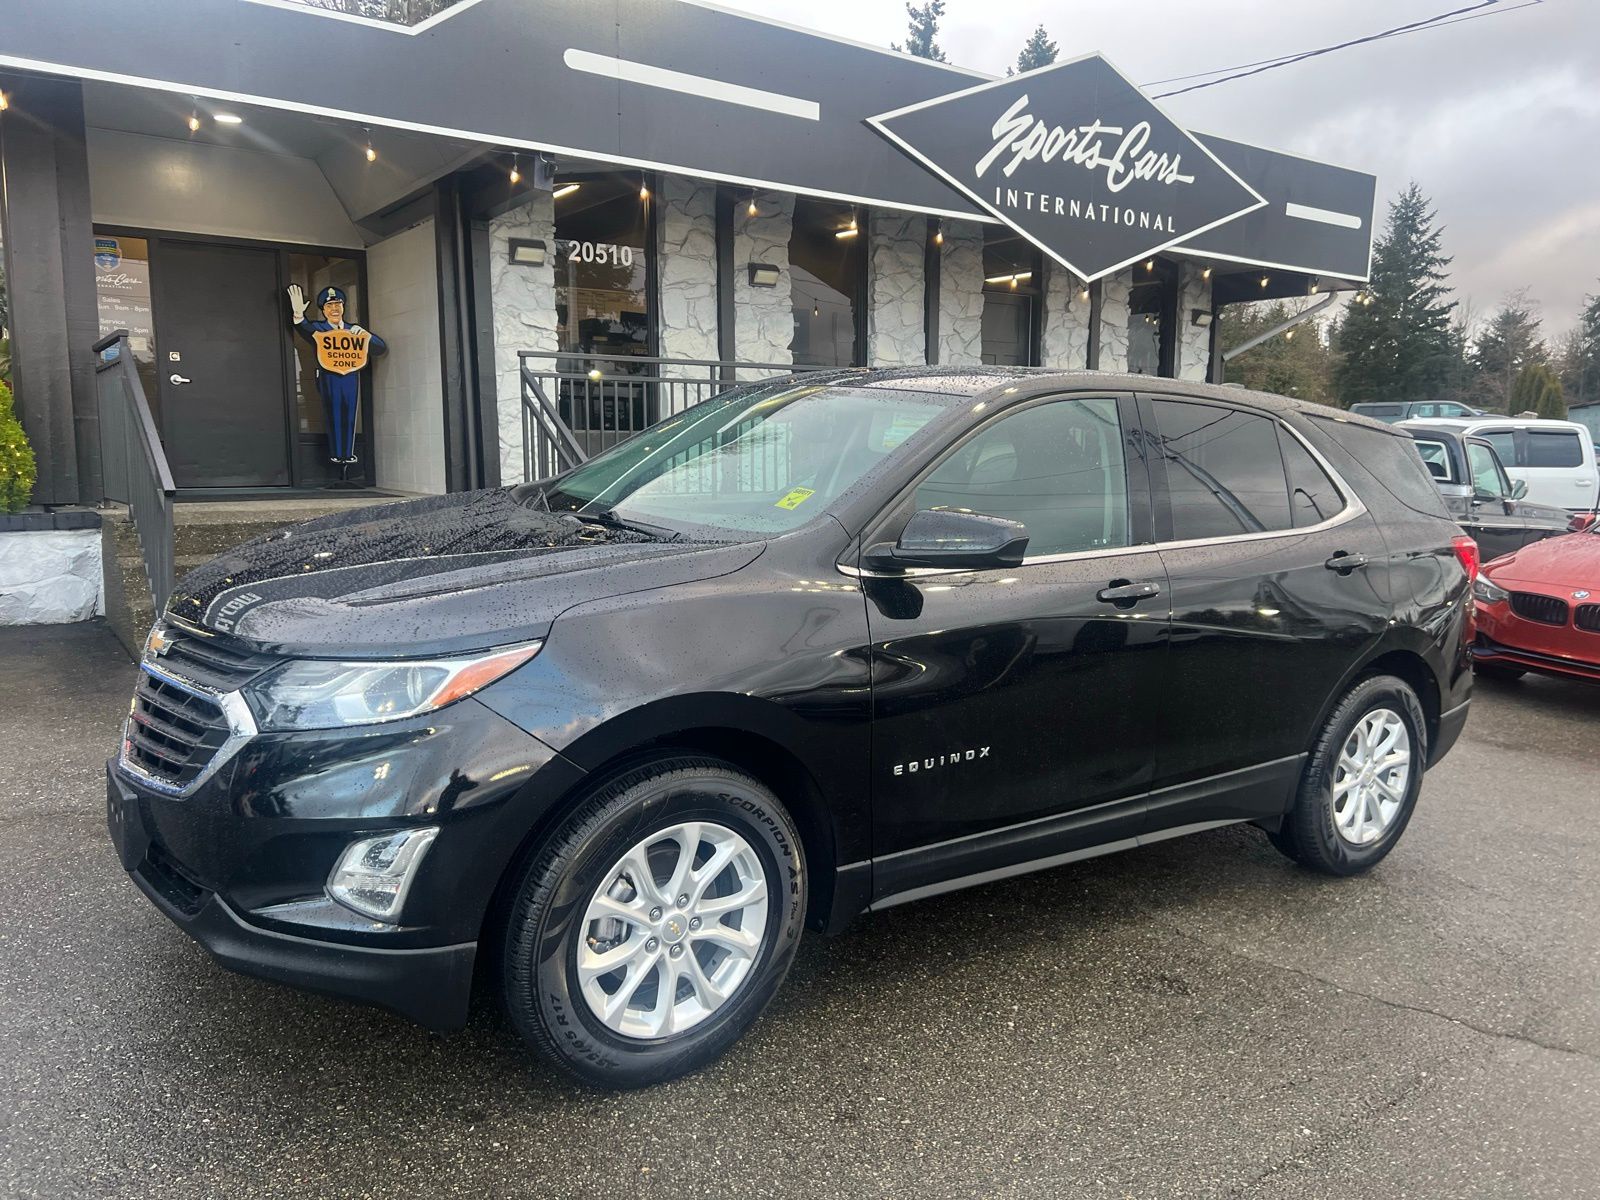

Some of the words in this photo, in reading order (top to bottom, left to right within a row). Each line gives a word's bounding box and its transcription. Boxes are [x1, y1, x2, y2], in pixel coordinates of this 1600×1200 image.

[975, 94, 1124, 178] Sports
[1106, 121, 1195, 192] Cars
[995, 186, 1176, 233] INTERNATIONAL
[568, 240, 633, 267] 20510
[323, 336, 364, 351] SLOW
[327, 351, 362, 359] SCHOOL
[893, 746, 990, 775] EQUINOX
[716, 792, 792, 857] SCORPION
[788, 865, 799, 895] AS
